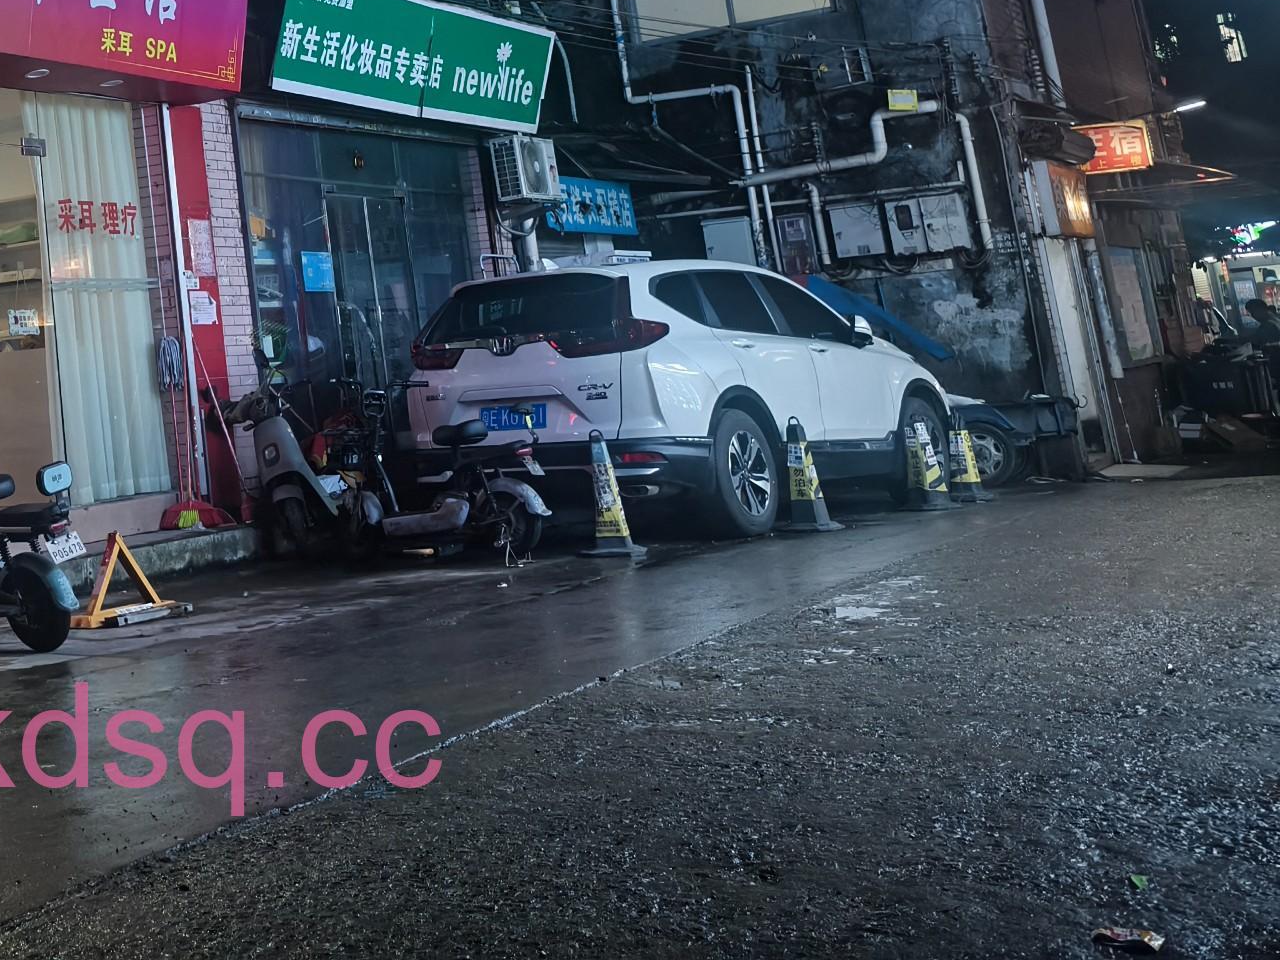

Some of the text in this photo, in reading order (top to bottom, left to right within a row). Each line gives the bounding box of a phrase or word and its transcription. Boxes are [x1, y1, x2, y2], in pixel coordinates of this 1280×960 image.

[101, 28, 178, 63] 采耳 SPA
[280, 19, 444, 89] 新生活化妆品专卖店
[57, 198, 138, 237] 采耳 理疗
[577, 382, 614, 392] CR-V
